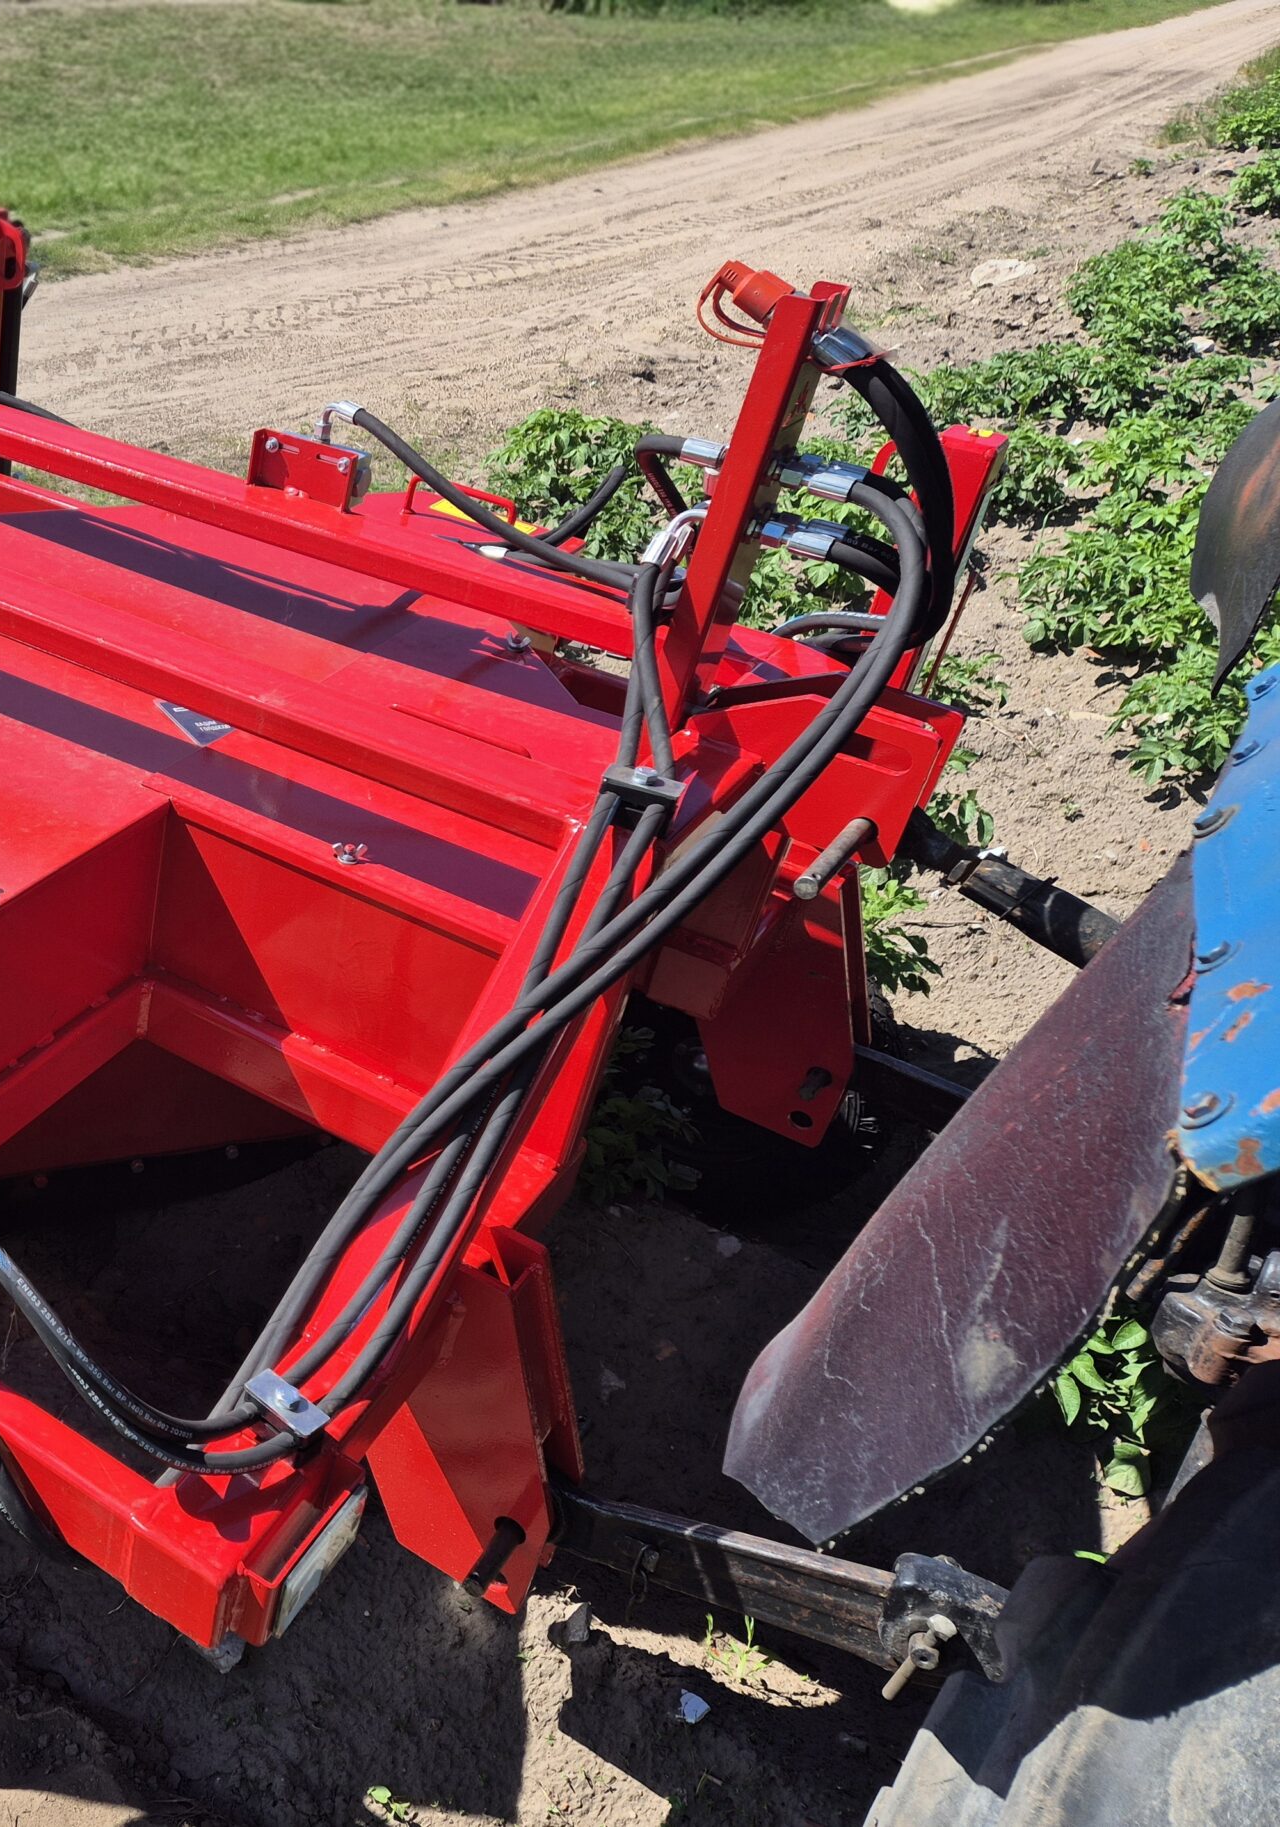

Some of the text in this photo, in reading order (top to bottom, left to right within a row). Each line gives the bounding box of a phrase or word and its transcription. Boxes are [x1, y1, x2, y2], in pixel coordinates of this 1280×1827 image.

[16, 1277, 41, 1307] EN853
[40, 1306, 57, 1326] 2SN
[88, 1390, 104, 1408] 2SN
